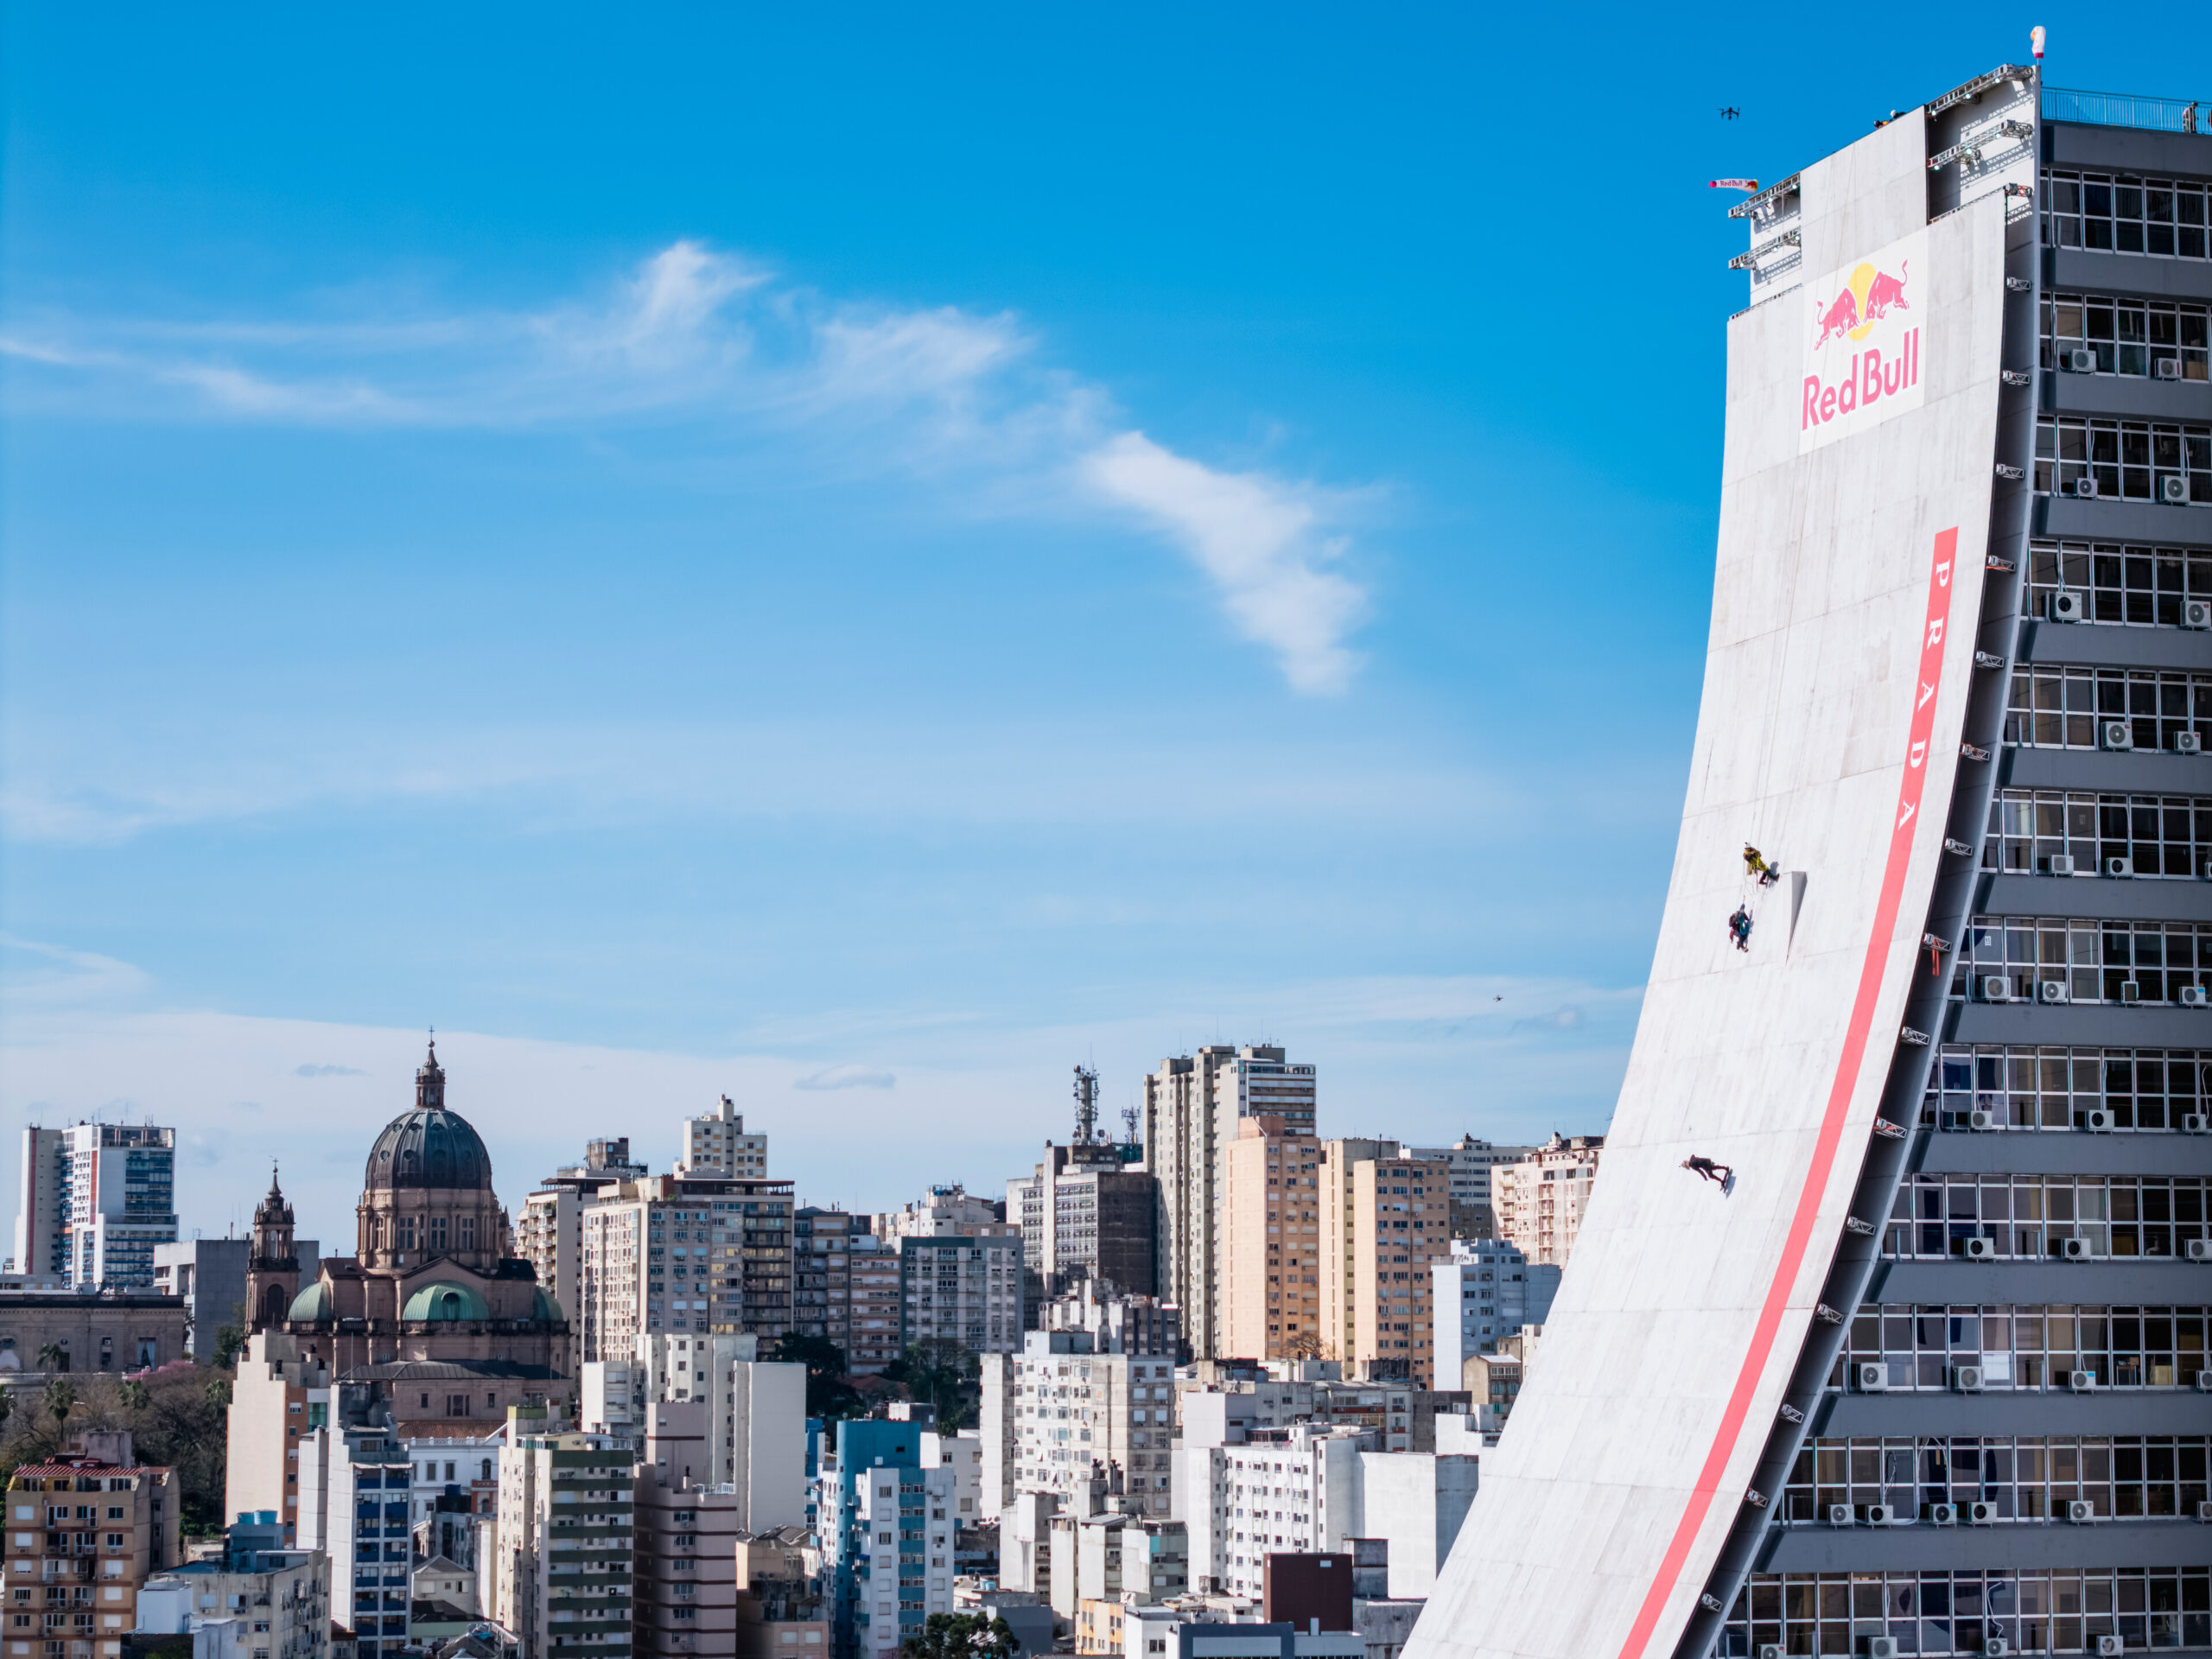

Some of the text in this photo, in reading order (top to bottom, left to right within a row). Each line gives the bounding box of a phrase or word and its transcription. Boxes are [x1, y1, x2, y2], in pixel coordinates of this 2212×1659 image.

[1802, 327, 1918, 431] Red Bull
[1898, 558, 1950, 830] PRADA
